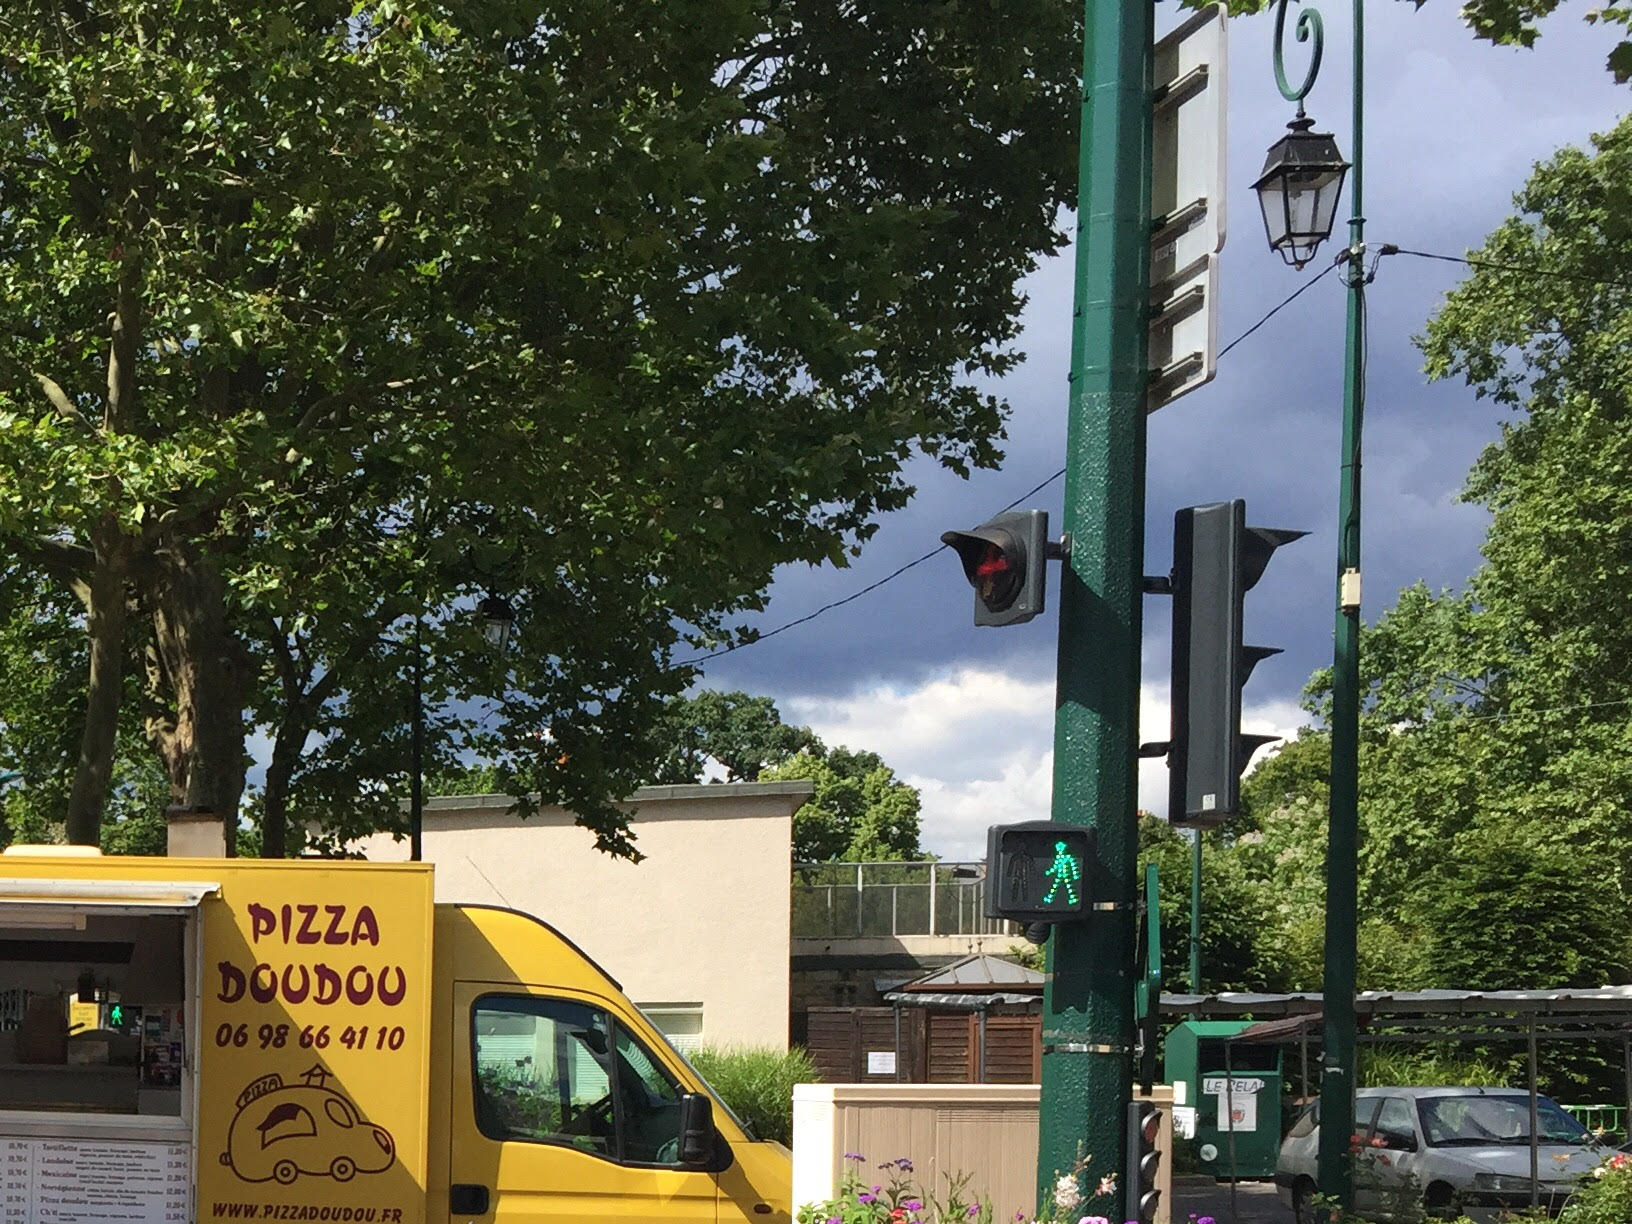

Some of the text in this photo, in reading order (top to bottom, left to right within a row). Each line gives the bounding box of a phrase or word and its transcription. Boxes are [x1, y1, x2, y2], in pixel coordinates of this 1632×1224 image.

[247, 902, 380, 946] PIZZA
[217, 961, 407, 1006] DOUDOU
[216, 1022, 405, 1050] 06 98 66 41 10
[243, 1078, 279, 1103] PIZZA
[1206, 1080, 1222, 1092] LE
[212, 1203, 403, 1224] WWW.PIZZADOUDOU.FR
